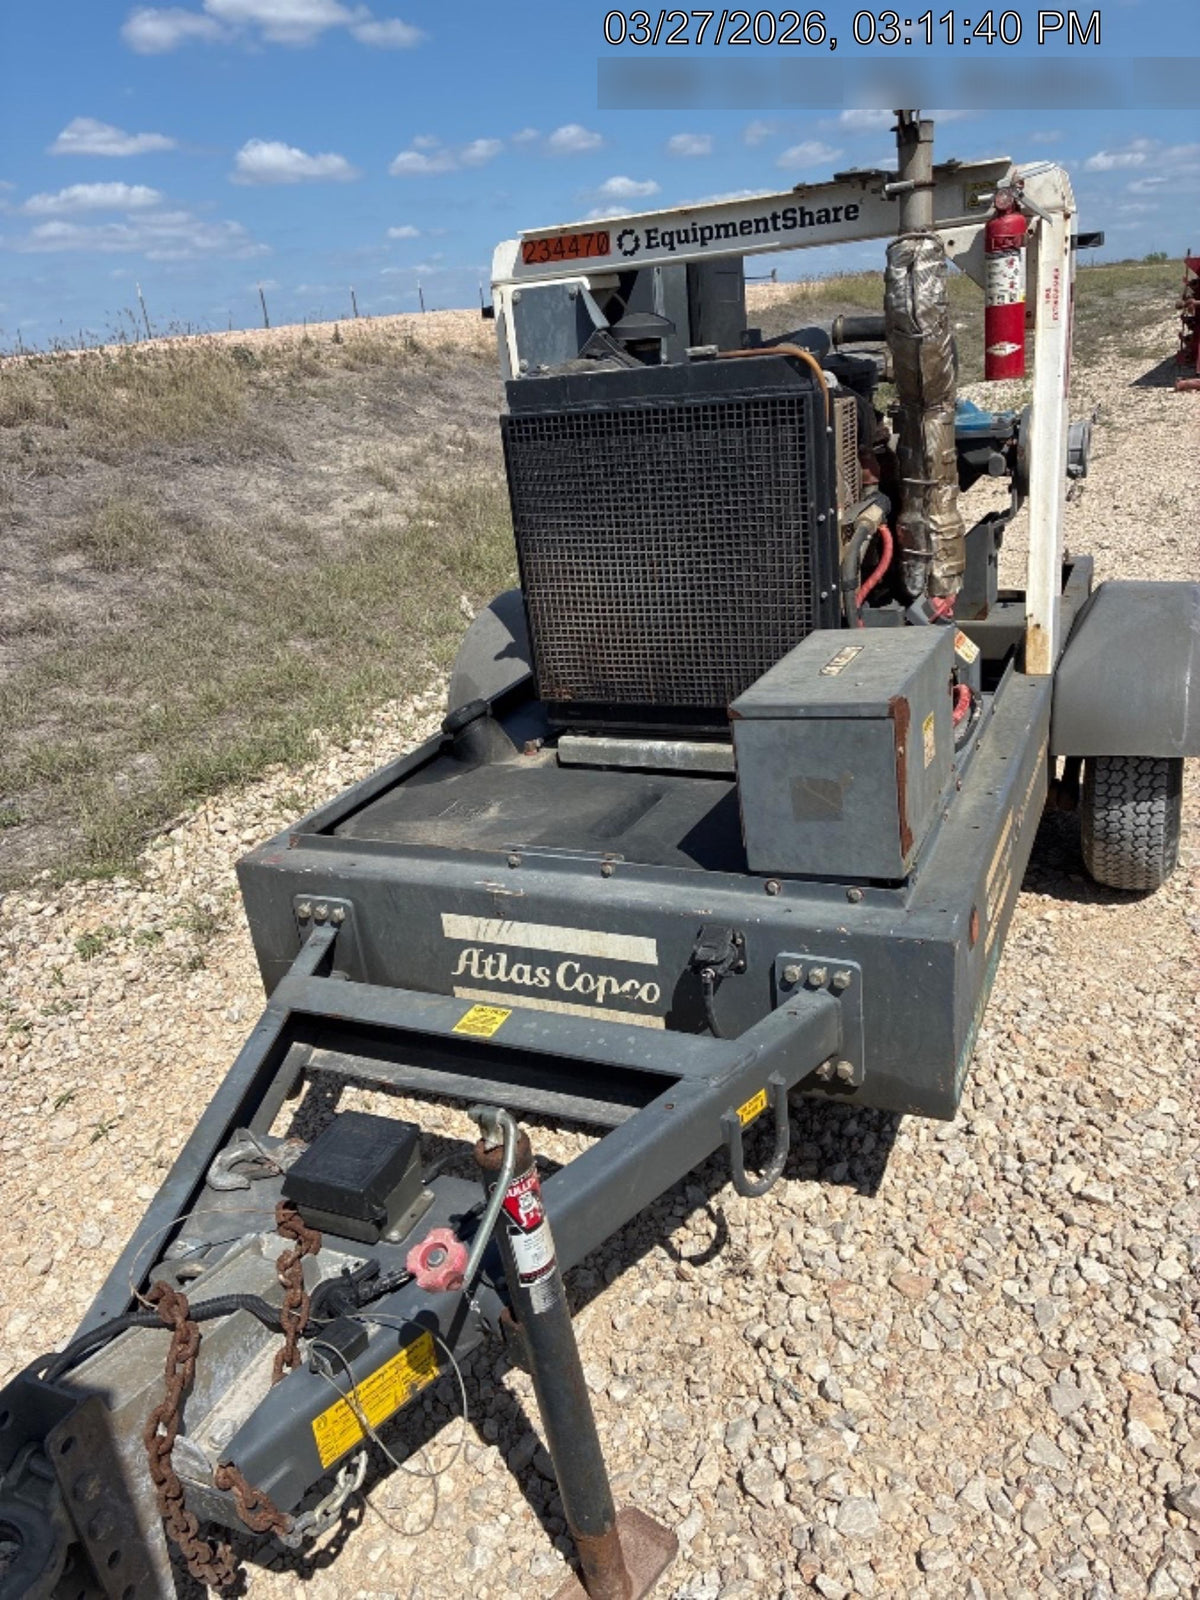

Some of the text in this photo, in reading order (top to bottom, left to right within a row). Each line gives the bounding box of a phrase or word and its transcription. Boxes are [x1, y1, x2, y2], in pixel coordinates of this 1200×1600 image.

[523, 203, 861, 264] 234470 EquipmentShare
[451, 947, 661, 1004] Atlas Copco
